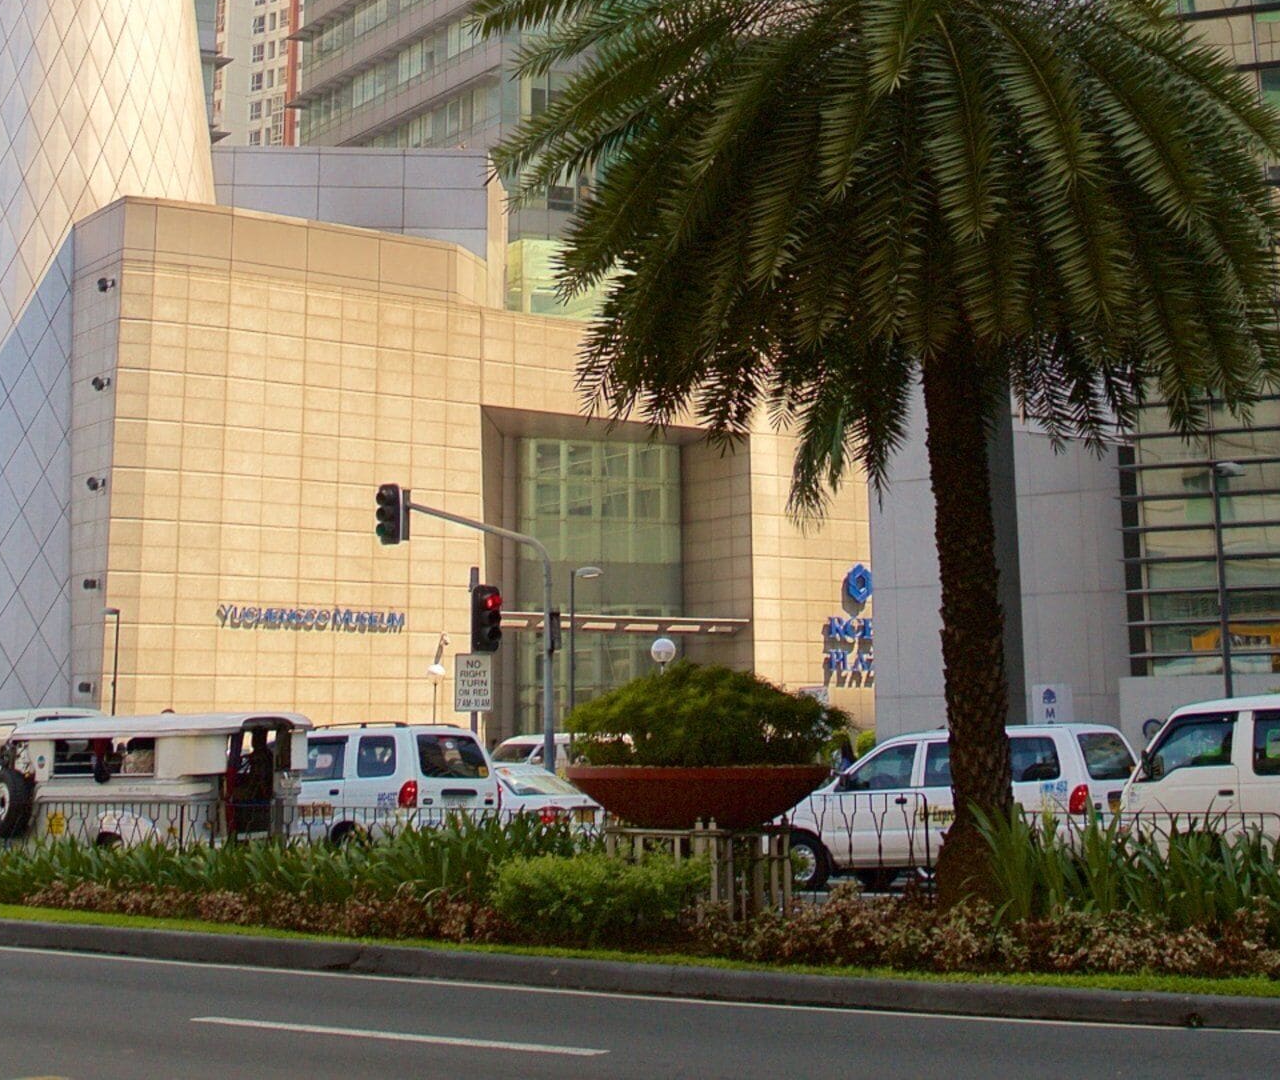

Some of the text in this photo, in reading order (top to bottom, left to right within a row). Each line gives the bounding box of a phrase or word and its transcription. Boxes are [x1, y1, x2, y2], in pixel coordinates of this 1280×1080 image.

[219, 604, 406, 628] YUCHENGCO MUSEUM
[466, 660, 480, 669] NO
[460, 670, 487, 678] RIGHT
[460, 679, 488, 687] TURN
[458, 688, 489, 696] ON RED
